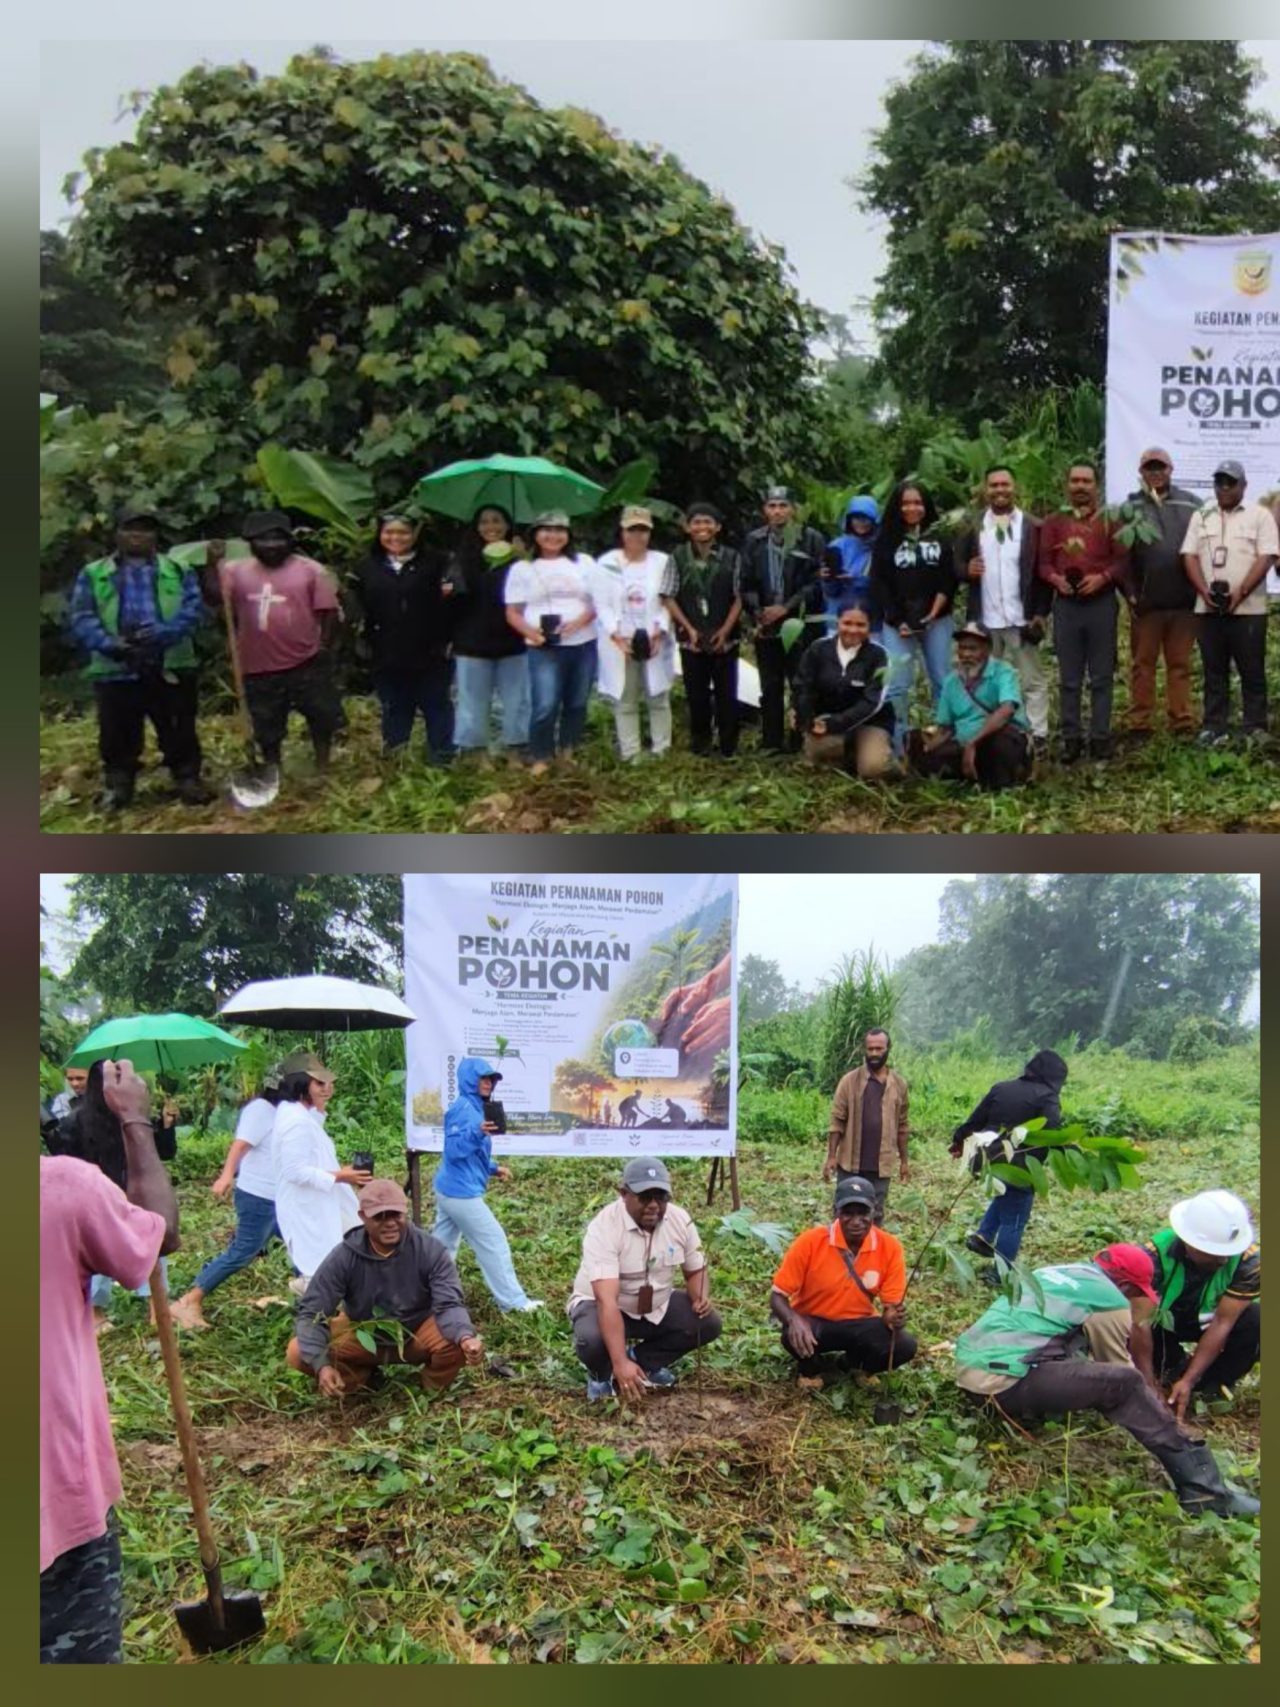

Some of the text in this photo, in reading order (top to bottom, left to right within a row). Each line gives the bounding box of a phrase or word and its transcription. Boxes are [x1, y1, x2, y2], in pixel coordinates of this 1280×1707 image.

[1194, 311, 1251, 326] KEGIATAN
[491, 881, 664, 906] KEGIATAN PENANAMAN POHON
[527, 919, 606, 938] Kegiatan
[458, 935, 631, 962] PENANAMAN
[458, 957, 610, 992] POHON
